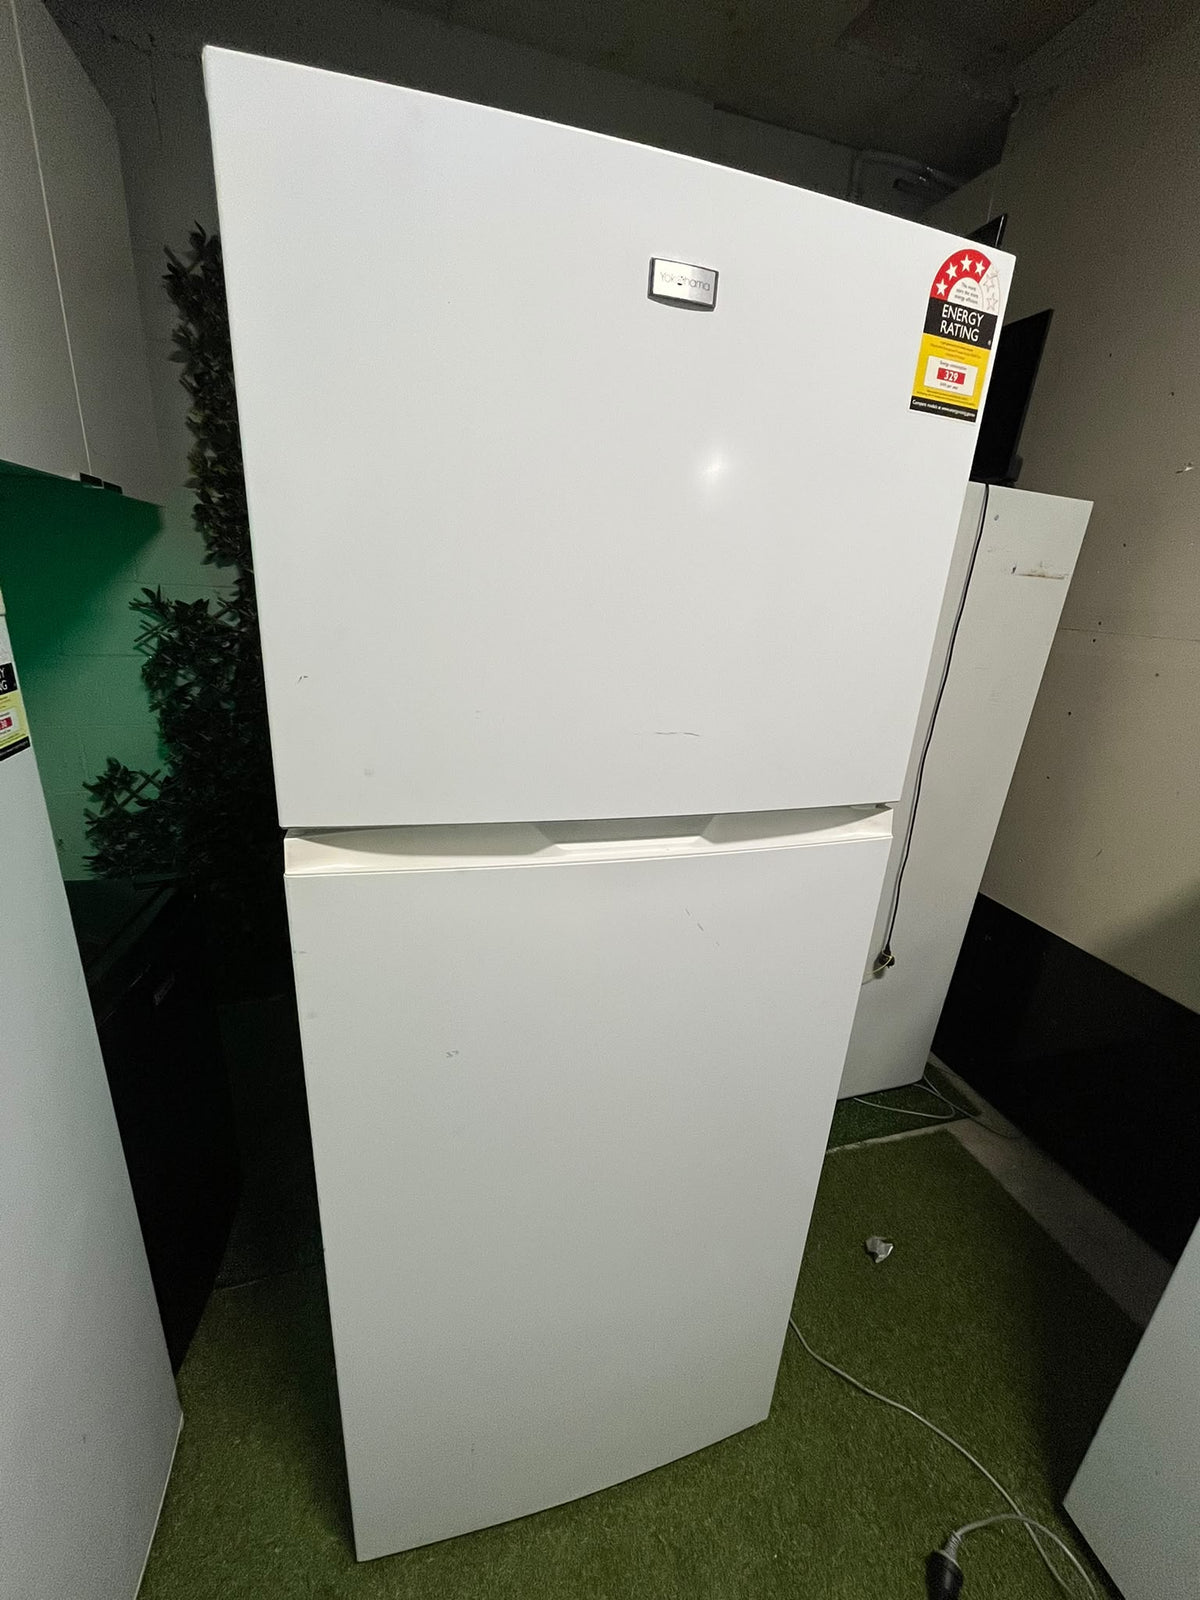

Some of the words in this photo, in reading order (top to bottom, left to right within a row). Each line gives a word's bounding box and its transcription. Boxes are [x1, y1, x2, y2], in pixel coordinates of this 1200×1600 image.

[942, 304, 984, 327] ENERGY
[940, 320, 979, 342] RATING
[944, 370, 959, 382] 329
